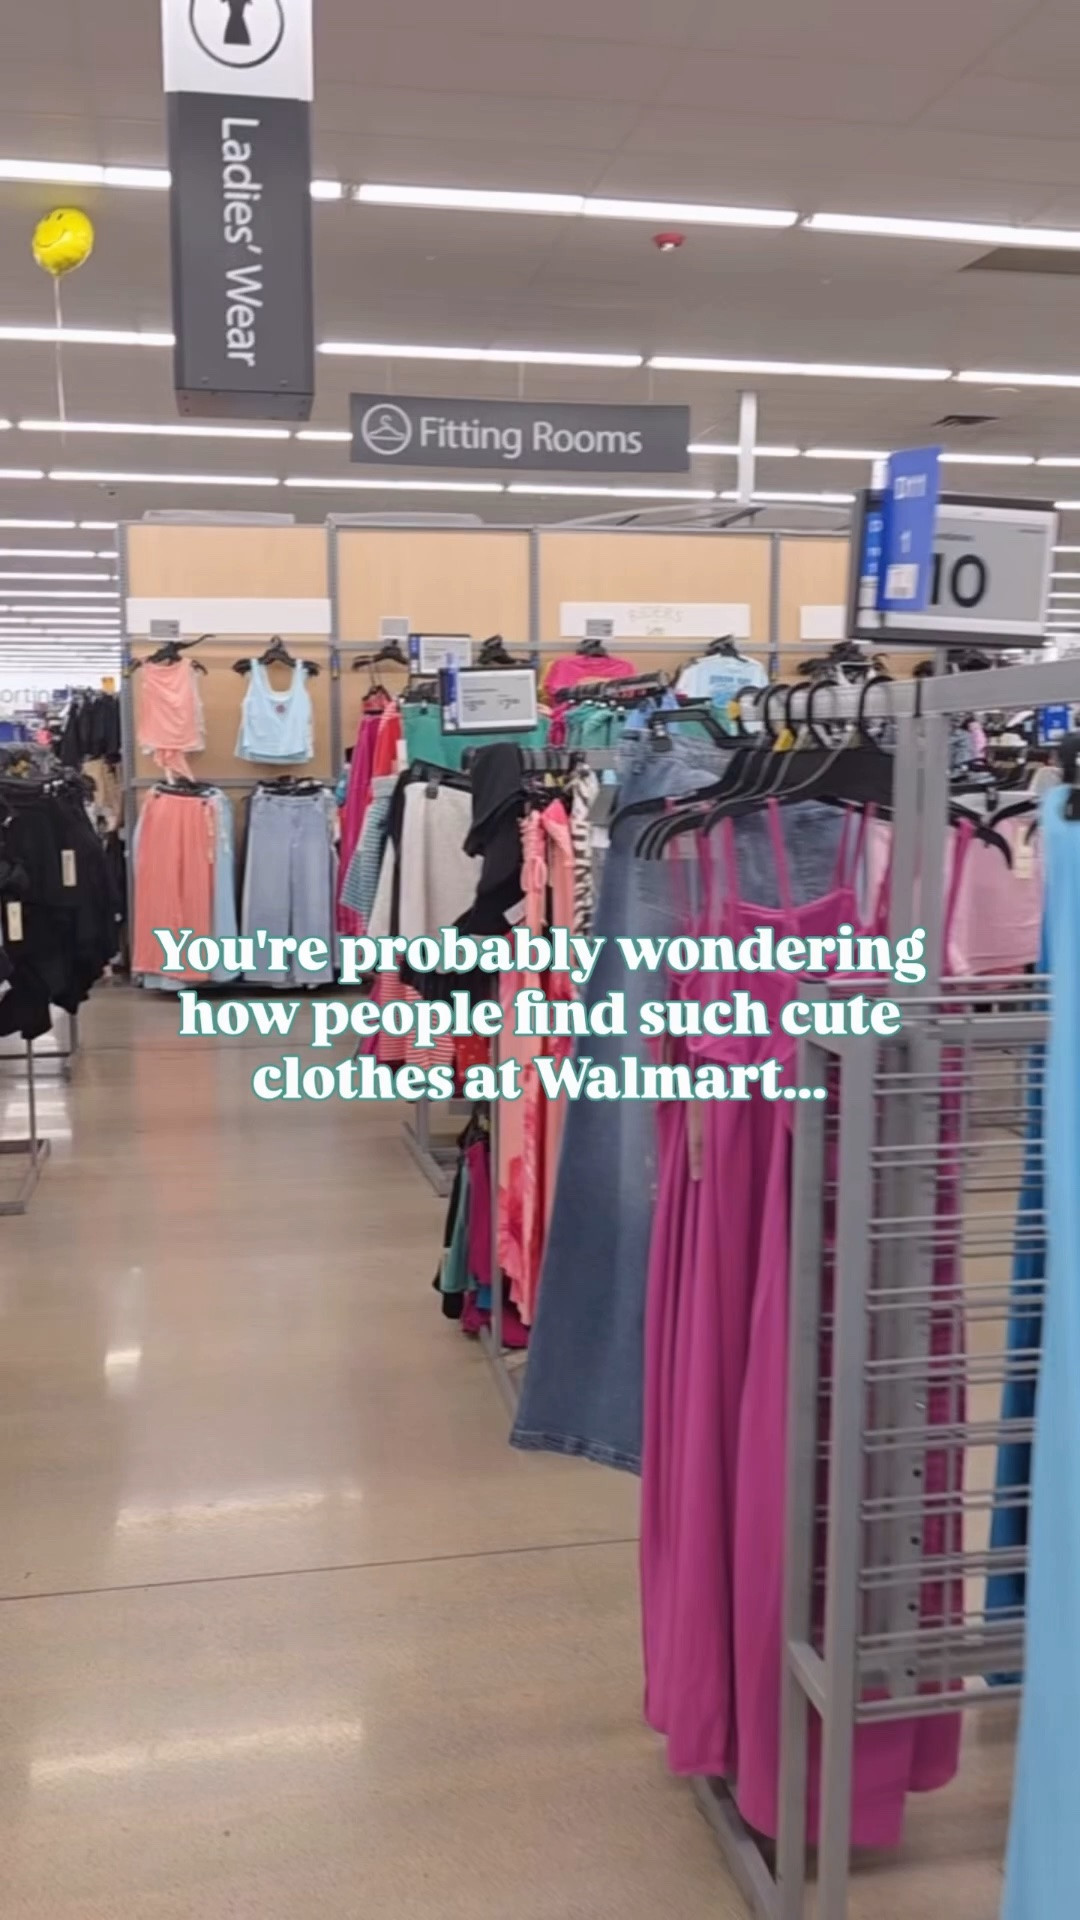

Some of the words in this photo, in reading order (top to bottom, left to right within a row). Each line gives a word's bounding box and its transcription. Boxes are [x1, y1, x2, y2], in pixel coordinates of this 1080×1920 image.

[225, 263, 264, 368] Wear
[419, 415, 523, 460] Fitting
[532, 420, 643, 455] Rooms
